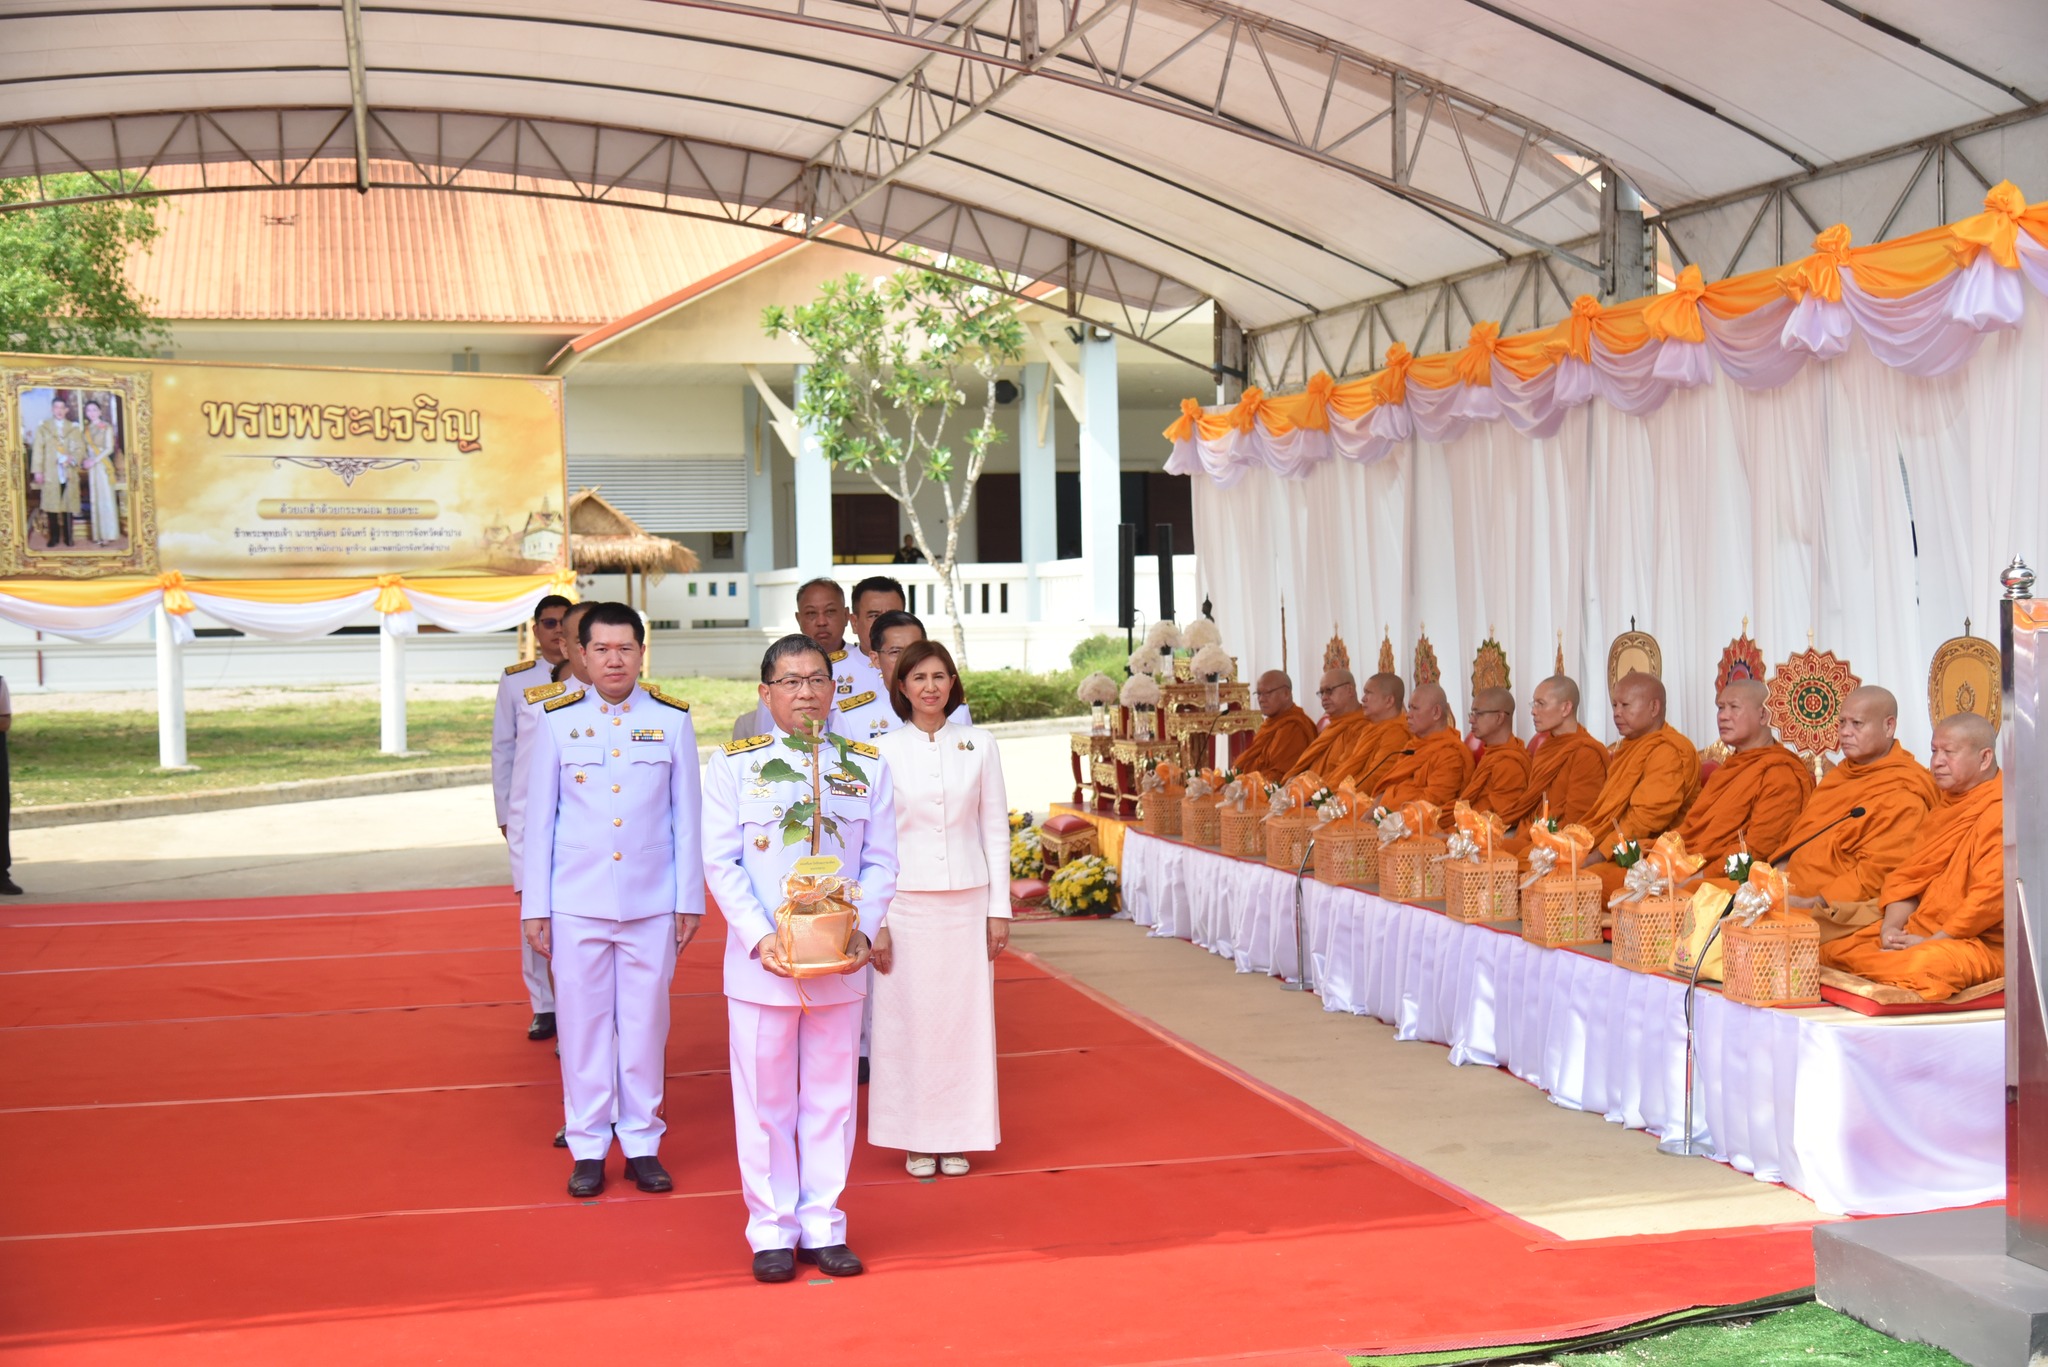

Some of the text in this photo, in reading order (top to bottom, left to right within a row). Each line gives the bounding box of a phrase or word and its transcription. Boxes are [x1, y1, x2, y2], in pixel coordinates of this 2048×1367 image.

[201, 393, 482, 453] ทรงพระเจริญ
